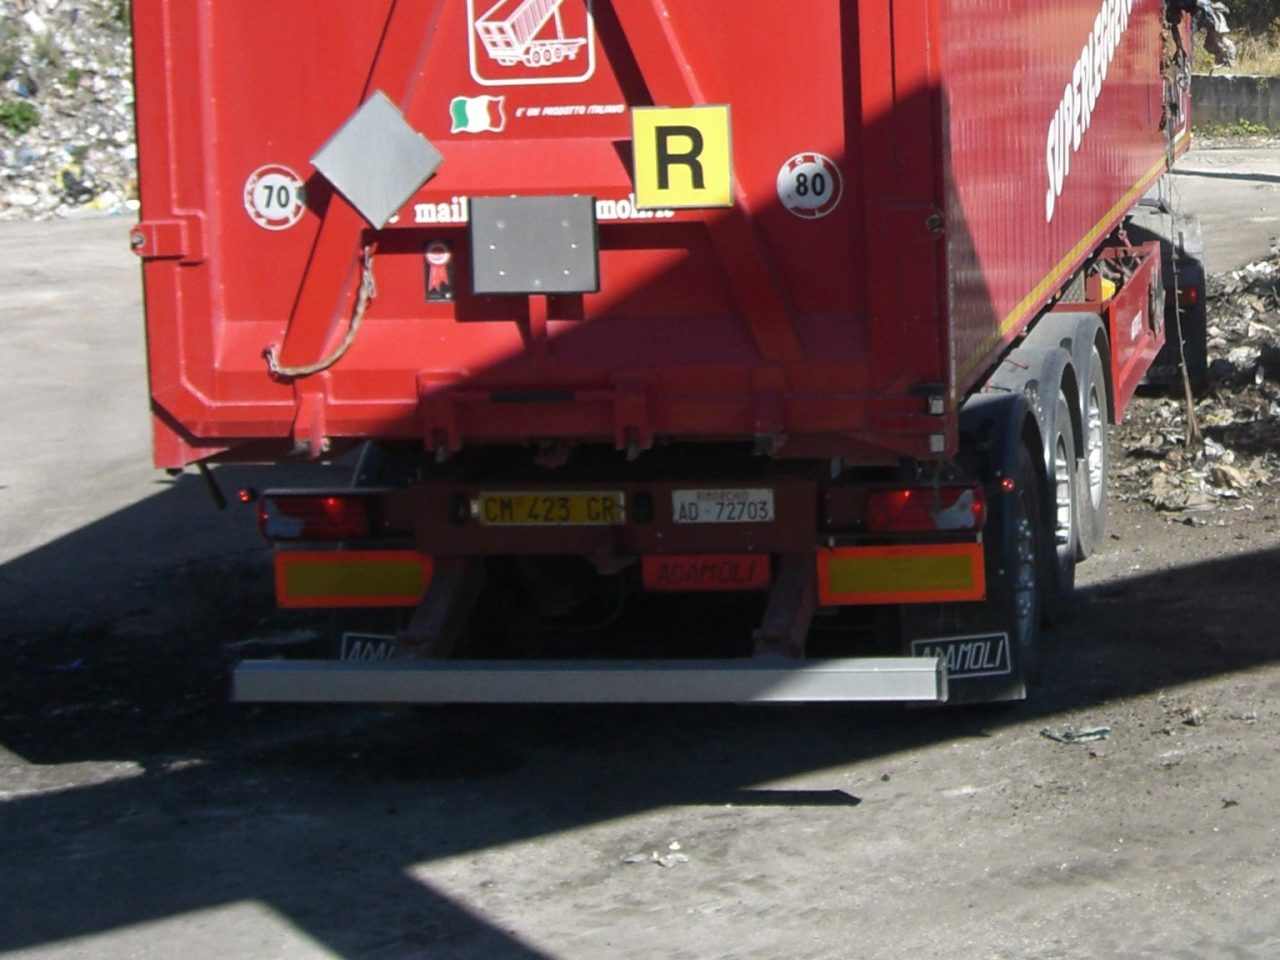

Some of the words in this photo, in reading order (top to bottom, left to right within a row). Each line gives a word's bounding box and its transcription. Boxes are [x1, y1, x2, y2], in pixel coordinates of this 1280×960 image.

[655, 125, 706, 190] R
[795, 172, 826, 197] 80
[262, 185, 290, 209] 70
[484, 497, 514, 522] CM
[527, 496, 571, 522] 423
[679, 502, 699, 521] AD
[715, 501, 769, 521] 72703
[656, 560, 757, 584] ADAMOLI
